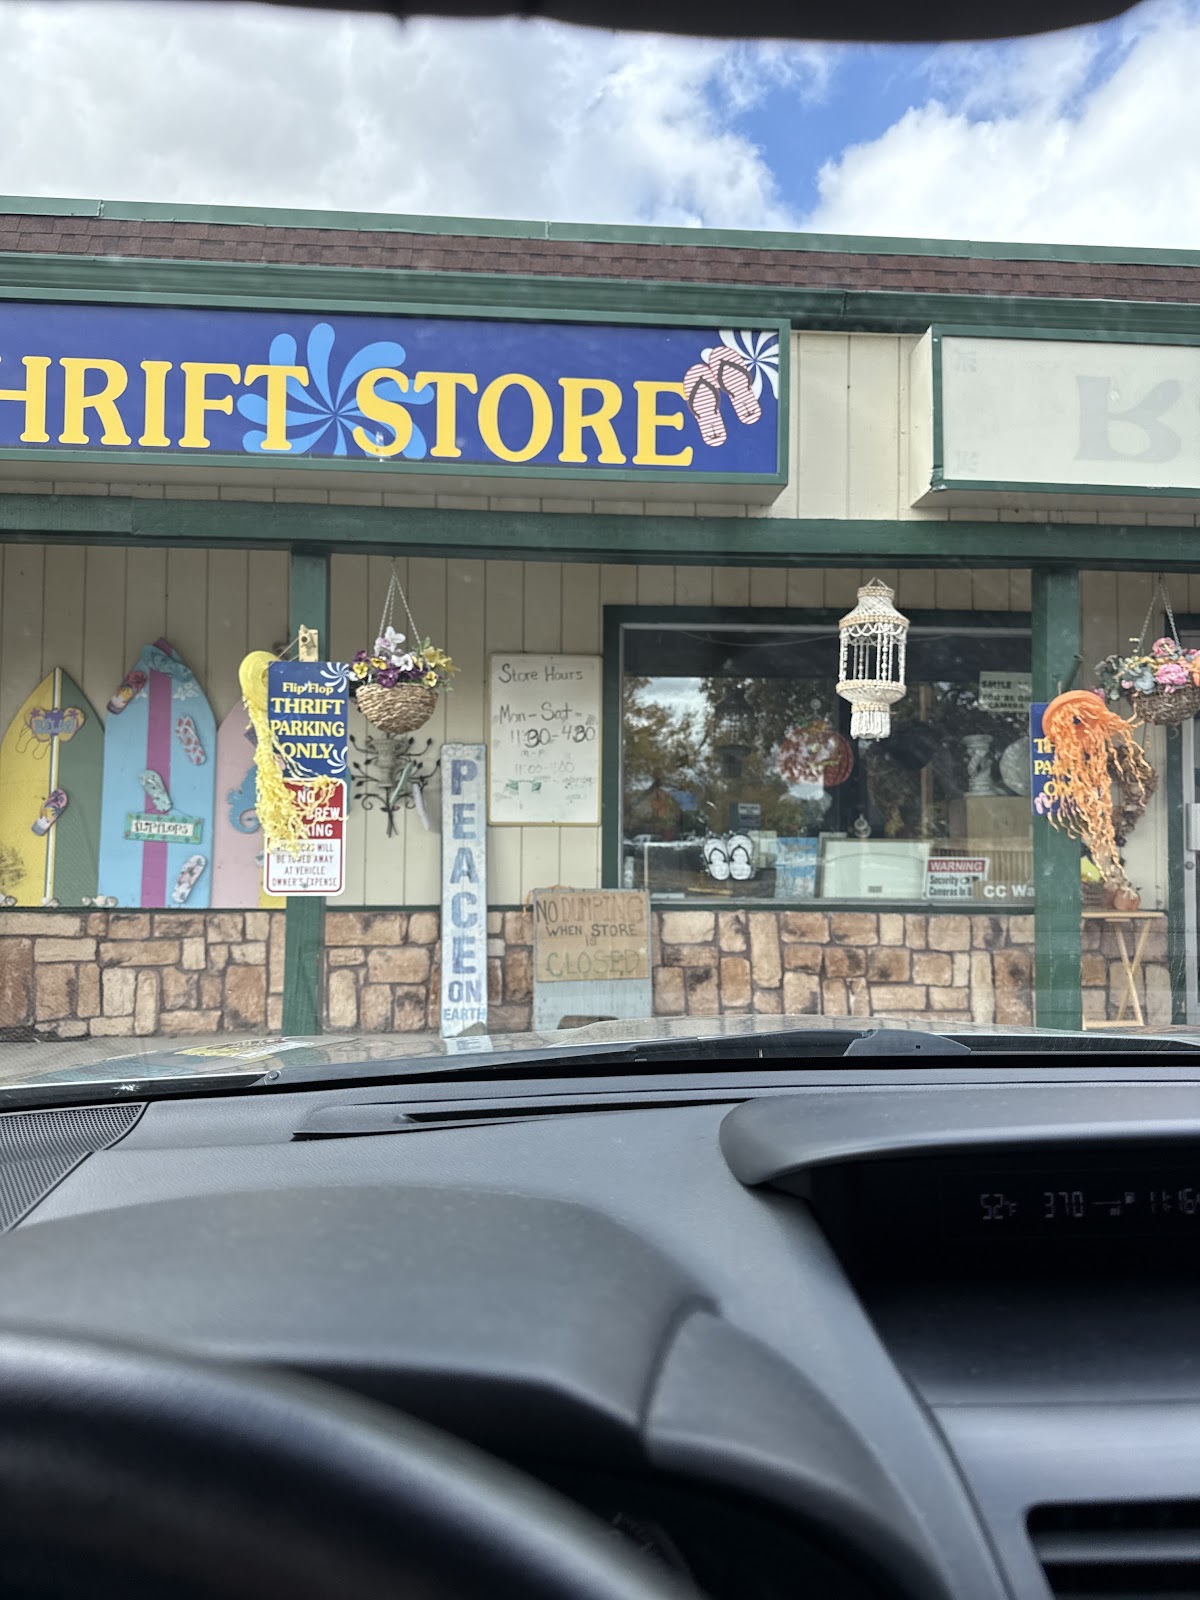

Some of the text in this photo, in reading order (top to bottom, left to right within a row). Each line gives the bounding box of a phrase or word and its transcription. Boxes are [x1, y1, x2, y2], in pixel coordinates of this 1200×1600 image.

[352, 366, 694, 467] STORE
[498, 663, 583, 683] Store Hours
[282, 682, 334, 696] Flip Flop
[270, 697, 345, 715] THRIFT
[270, 719, 345, 737] PARKING
[280, 742, 334, 759] ONLY
[314, 855, 334, 864] AWAY
[450, 759, 479, 975] PEACE
[930, 861, 982, 871] WARNING
[295, 866, 325, 875] VEHICLE
[306, 878, 337, 887] EXPENSE
[929, 875, 958, 886] Security
[929, 886, 957, 896] Cameras
[536, 896, 644, 924] NO DUMPING
[546, 923, 638, 937] WHEN STORE
[585, 935, 597, 946] IS
[546, 949, 640, 977] CLOSED
[447, 981, 482, 1003] ON
[443, 1008, 486, 1021] EARTH
[1043, 1191, 1084, 1218] 370
